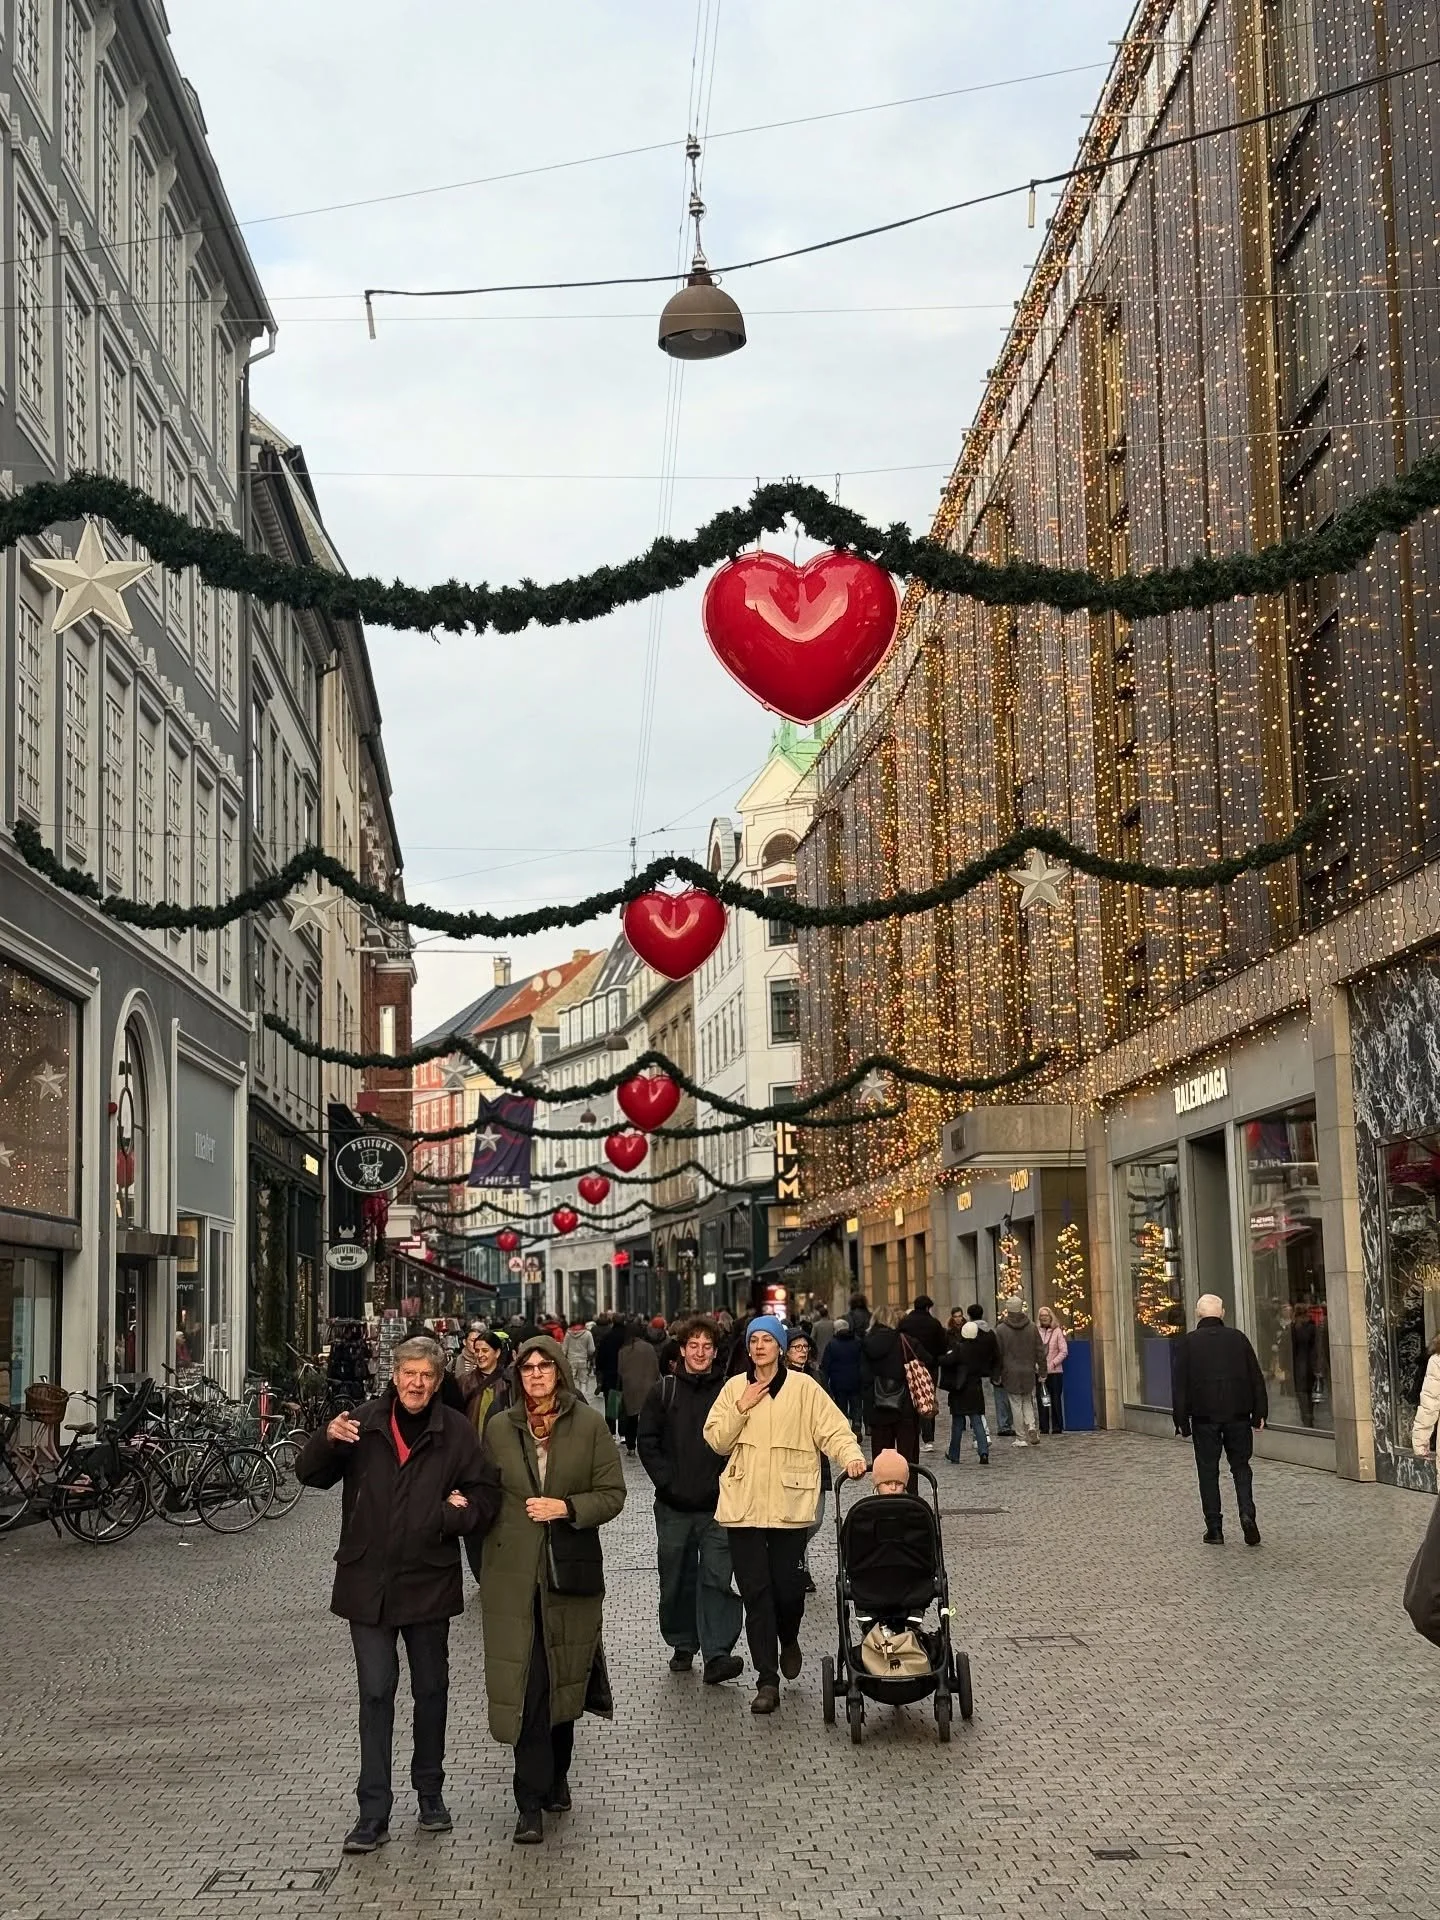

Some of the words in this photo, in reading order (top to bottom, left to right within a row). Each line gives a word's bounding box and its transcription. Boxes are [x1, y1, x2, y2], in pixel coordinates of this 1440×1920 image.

[1174, 1067, 1228, 1114] BALENCIAGA
[350, 1139, 394, 1152] PETITGAS
[478, 1175, 521, 1186] THIELE
